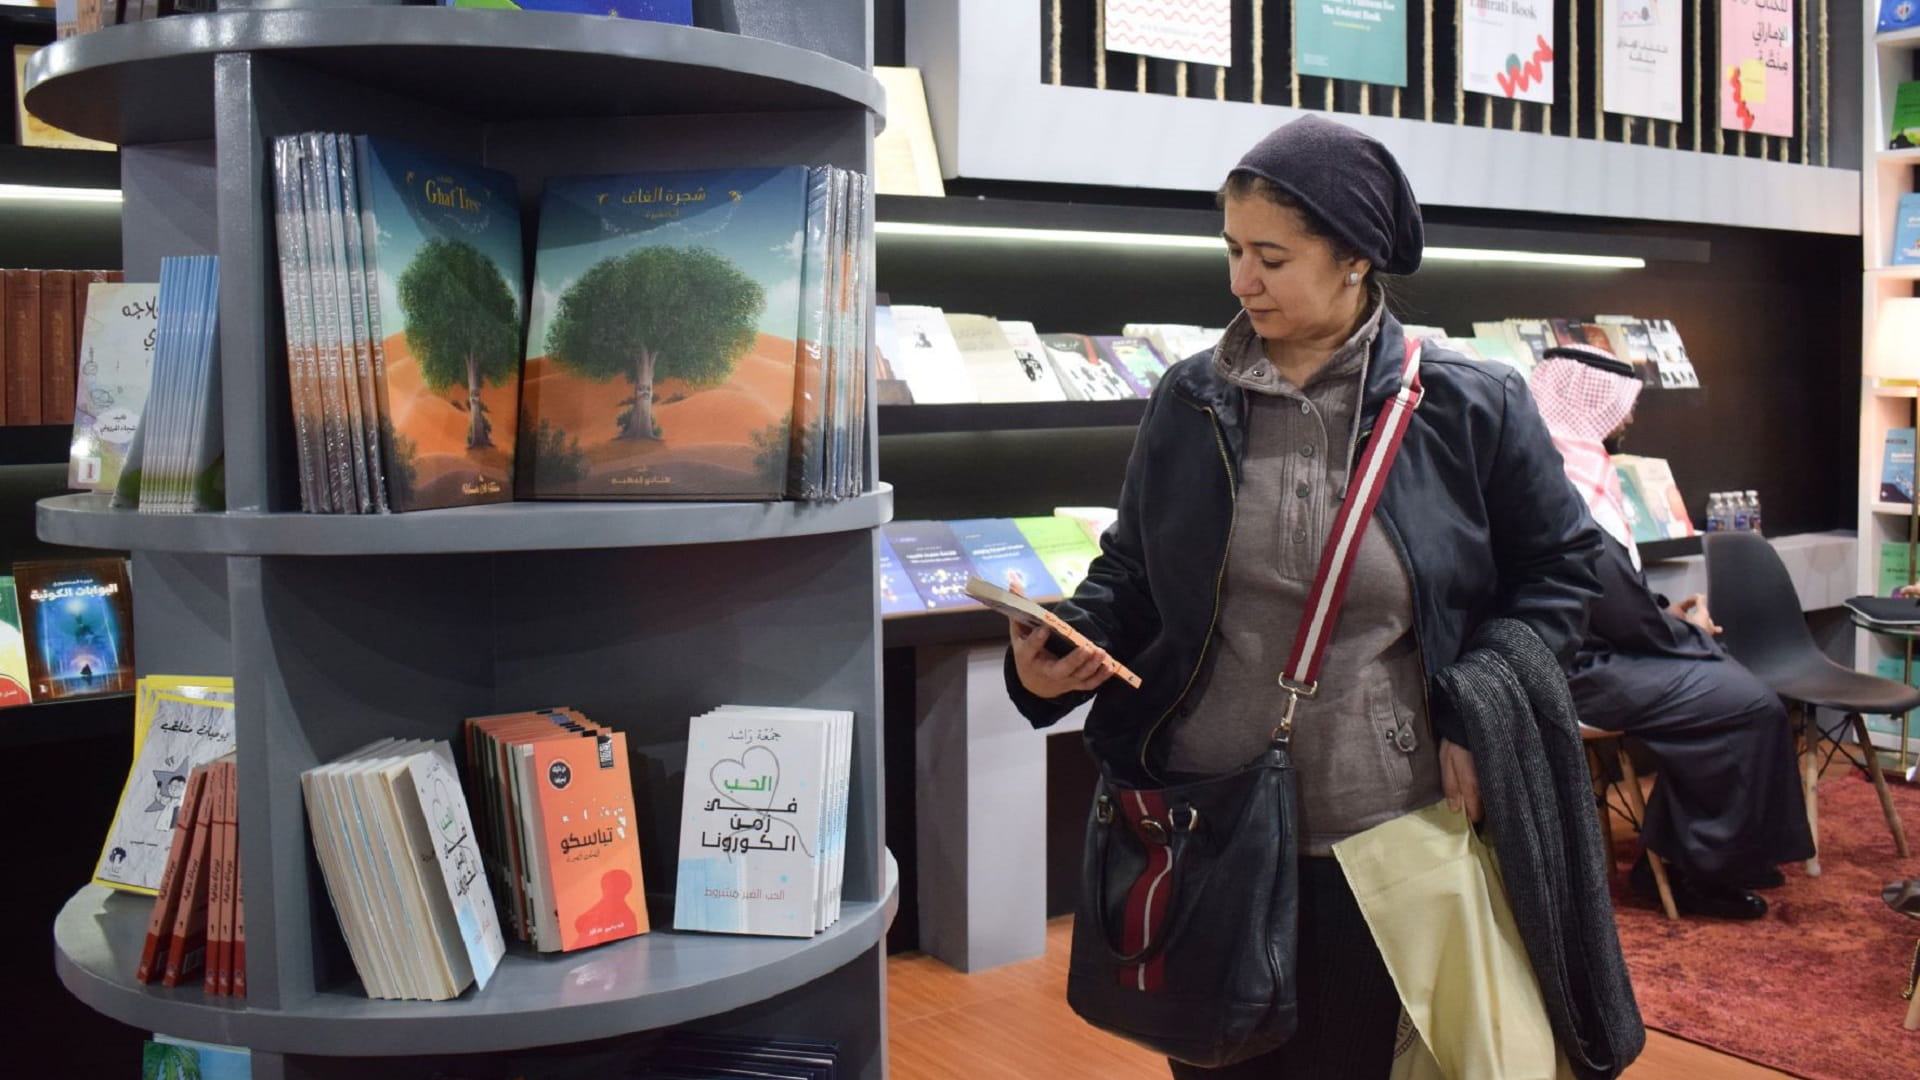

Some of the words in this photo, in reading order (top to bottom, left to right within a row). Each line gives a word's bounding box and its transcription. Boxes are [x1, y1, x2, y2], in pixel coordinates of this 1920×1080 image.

[1511, 0, 1537, 20] Book
[425, 179, 456, 208] Ghaf
[622, 186, 664, 204] الغاف
[665, 186, 706, 206] شجرة
[121, 295, 160, 320] لاجه
[374, 352, 383, 376] Tree
[30, 587, 73, 602] الكونية
[75, 583, 119, 598] البوابات
[197, 723, 231, 743] يوميات
[724, 776, 772, 793] الحب
[704, 798, 798, 813] في
[730, 813, 771, 832] زمن
[560, 827, 613, 854] تباسكو
[702, 831, 796, 853] الكورونا
